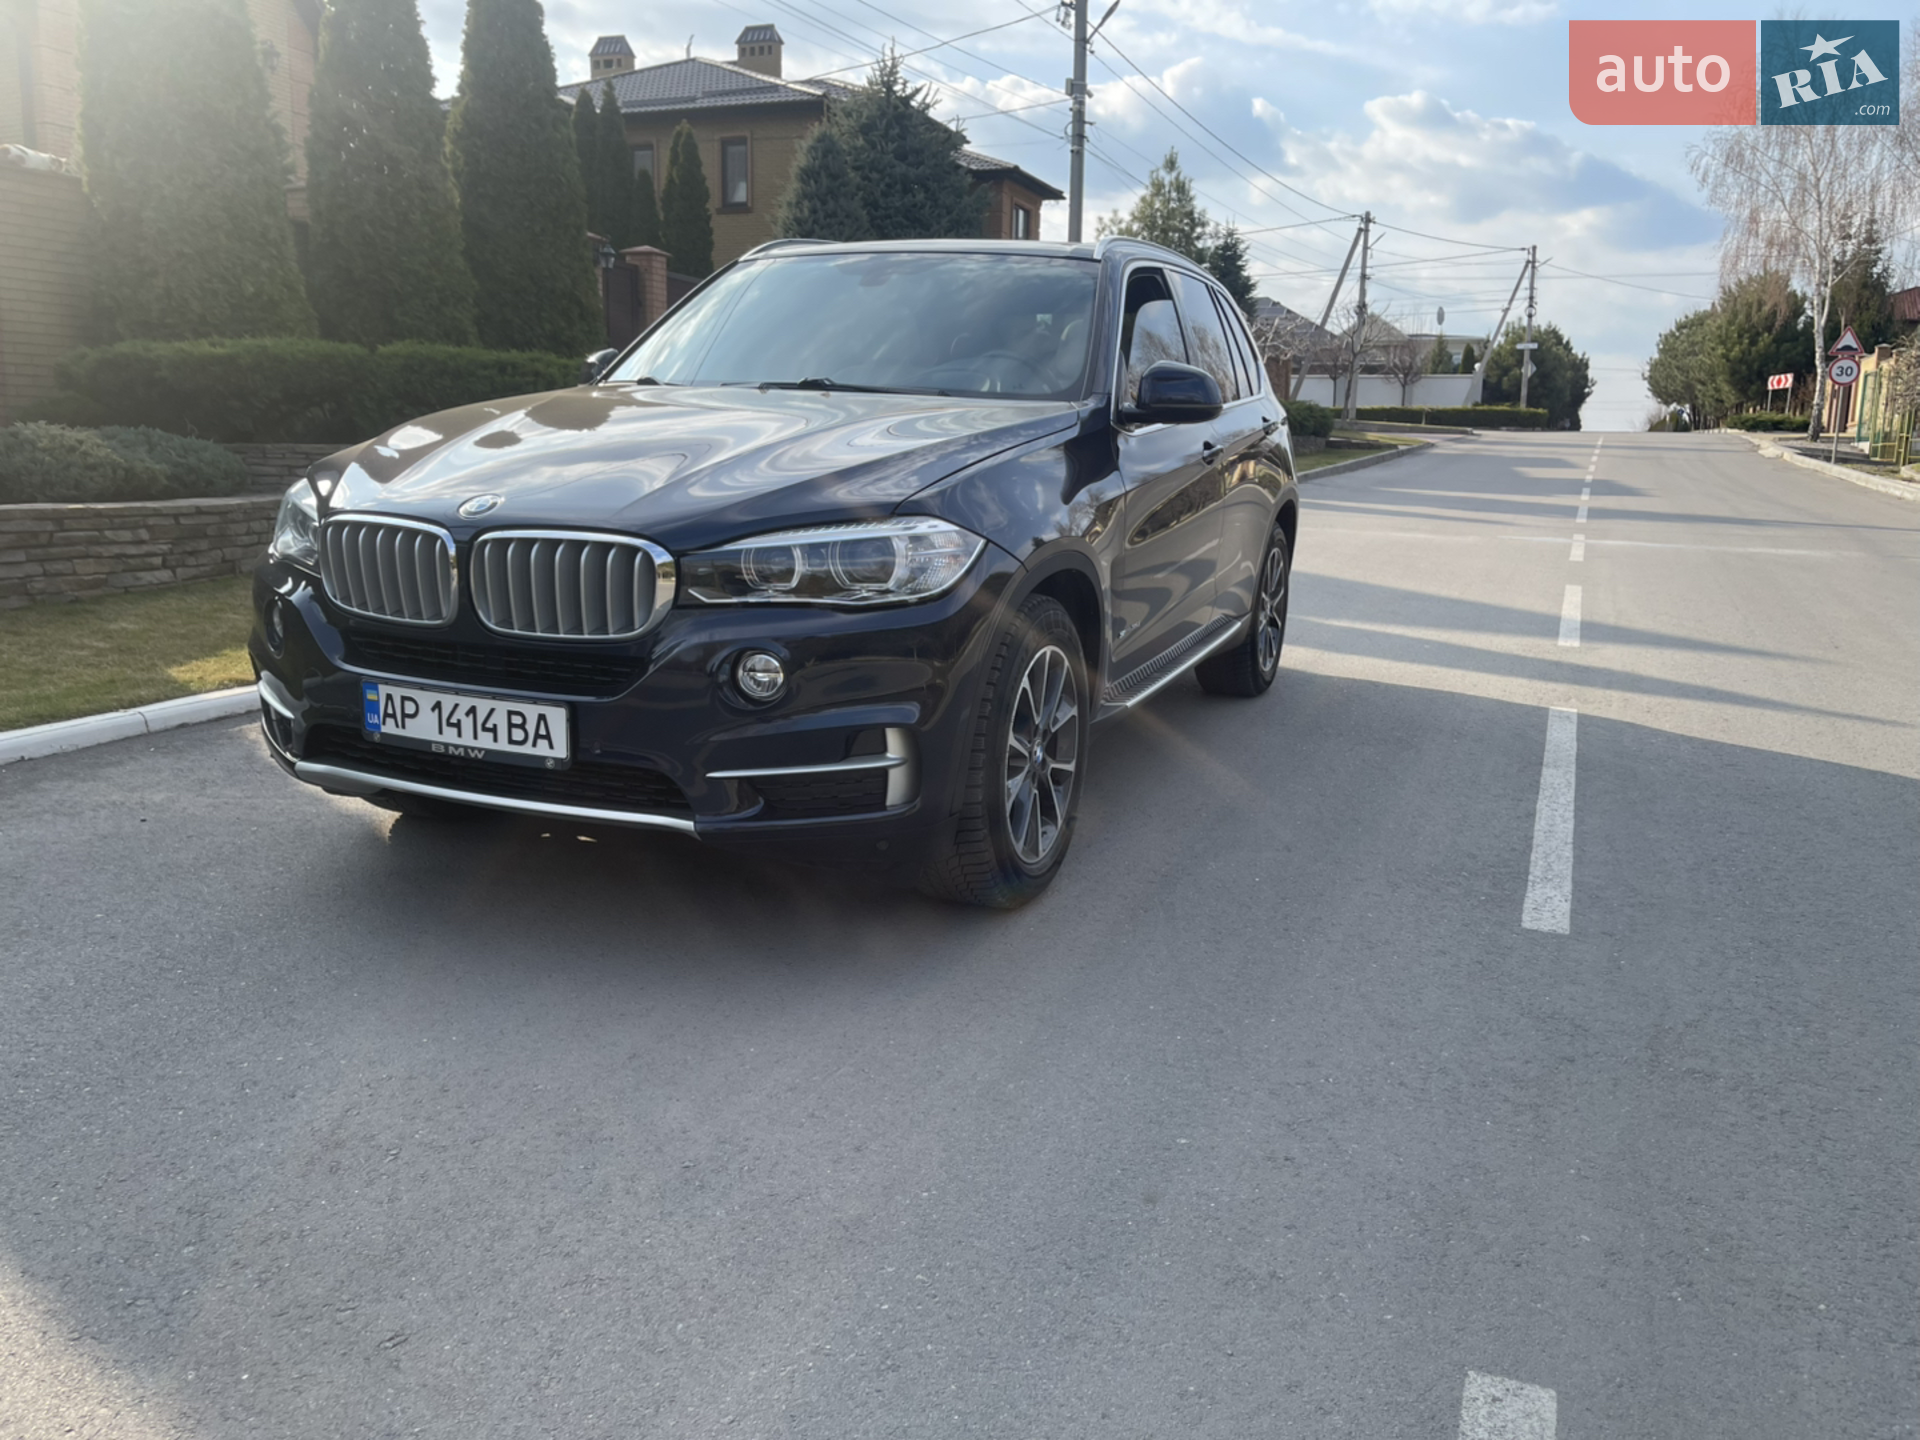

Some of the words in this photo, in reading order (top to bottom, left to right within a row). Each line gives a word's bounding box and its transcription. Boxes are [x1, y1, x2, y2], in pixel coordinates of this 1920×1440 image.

[1835, 365, 1854, 377] 30
[367, 712, 380, 725] UA
[381, 692, 420, 730] AP
[430, 700, 498, 743] 1414
[507, 709, 555, 750] BA
[431, 743, 486, 760] BMW
